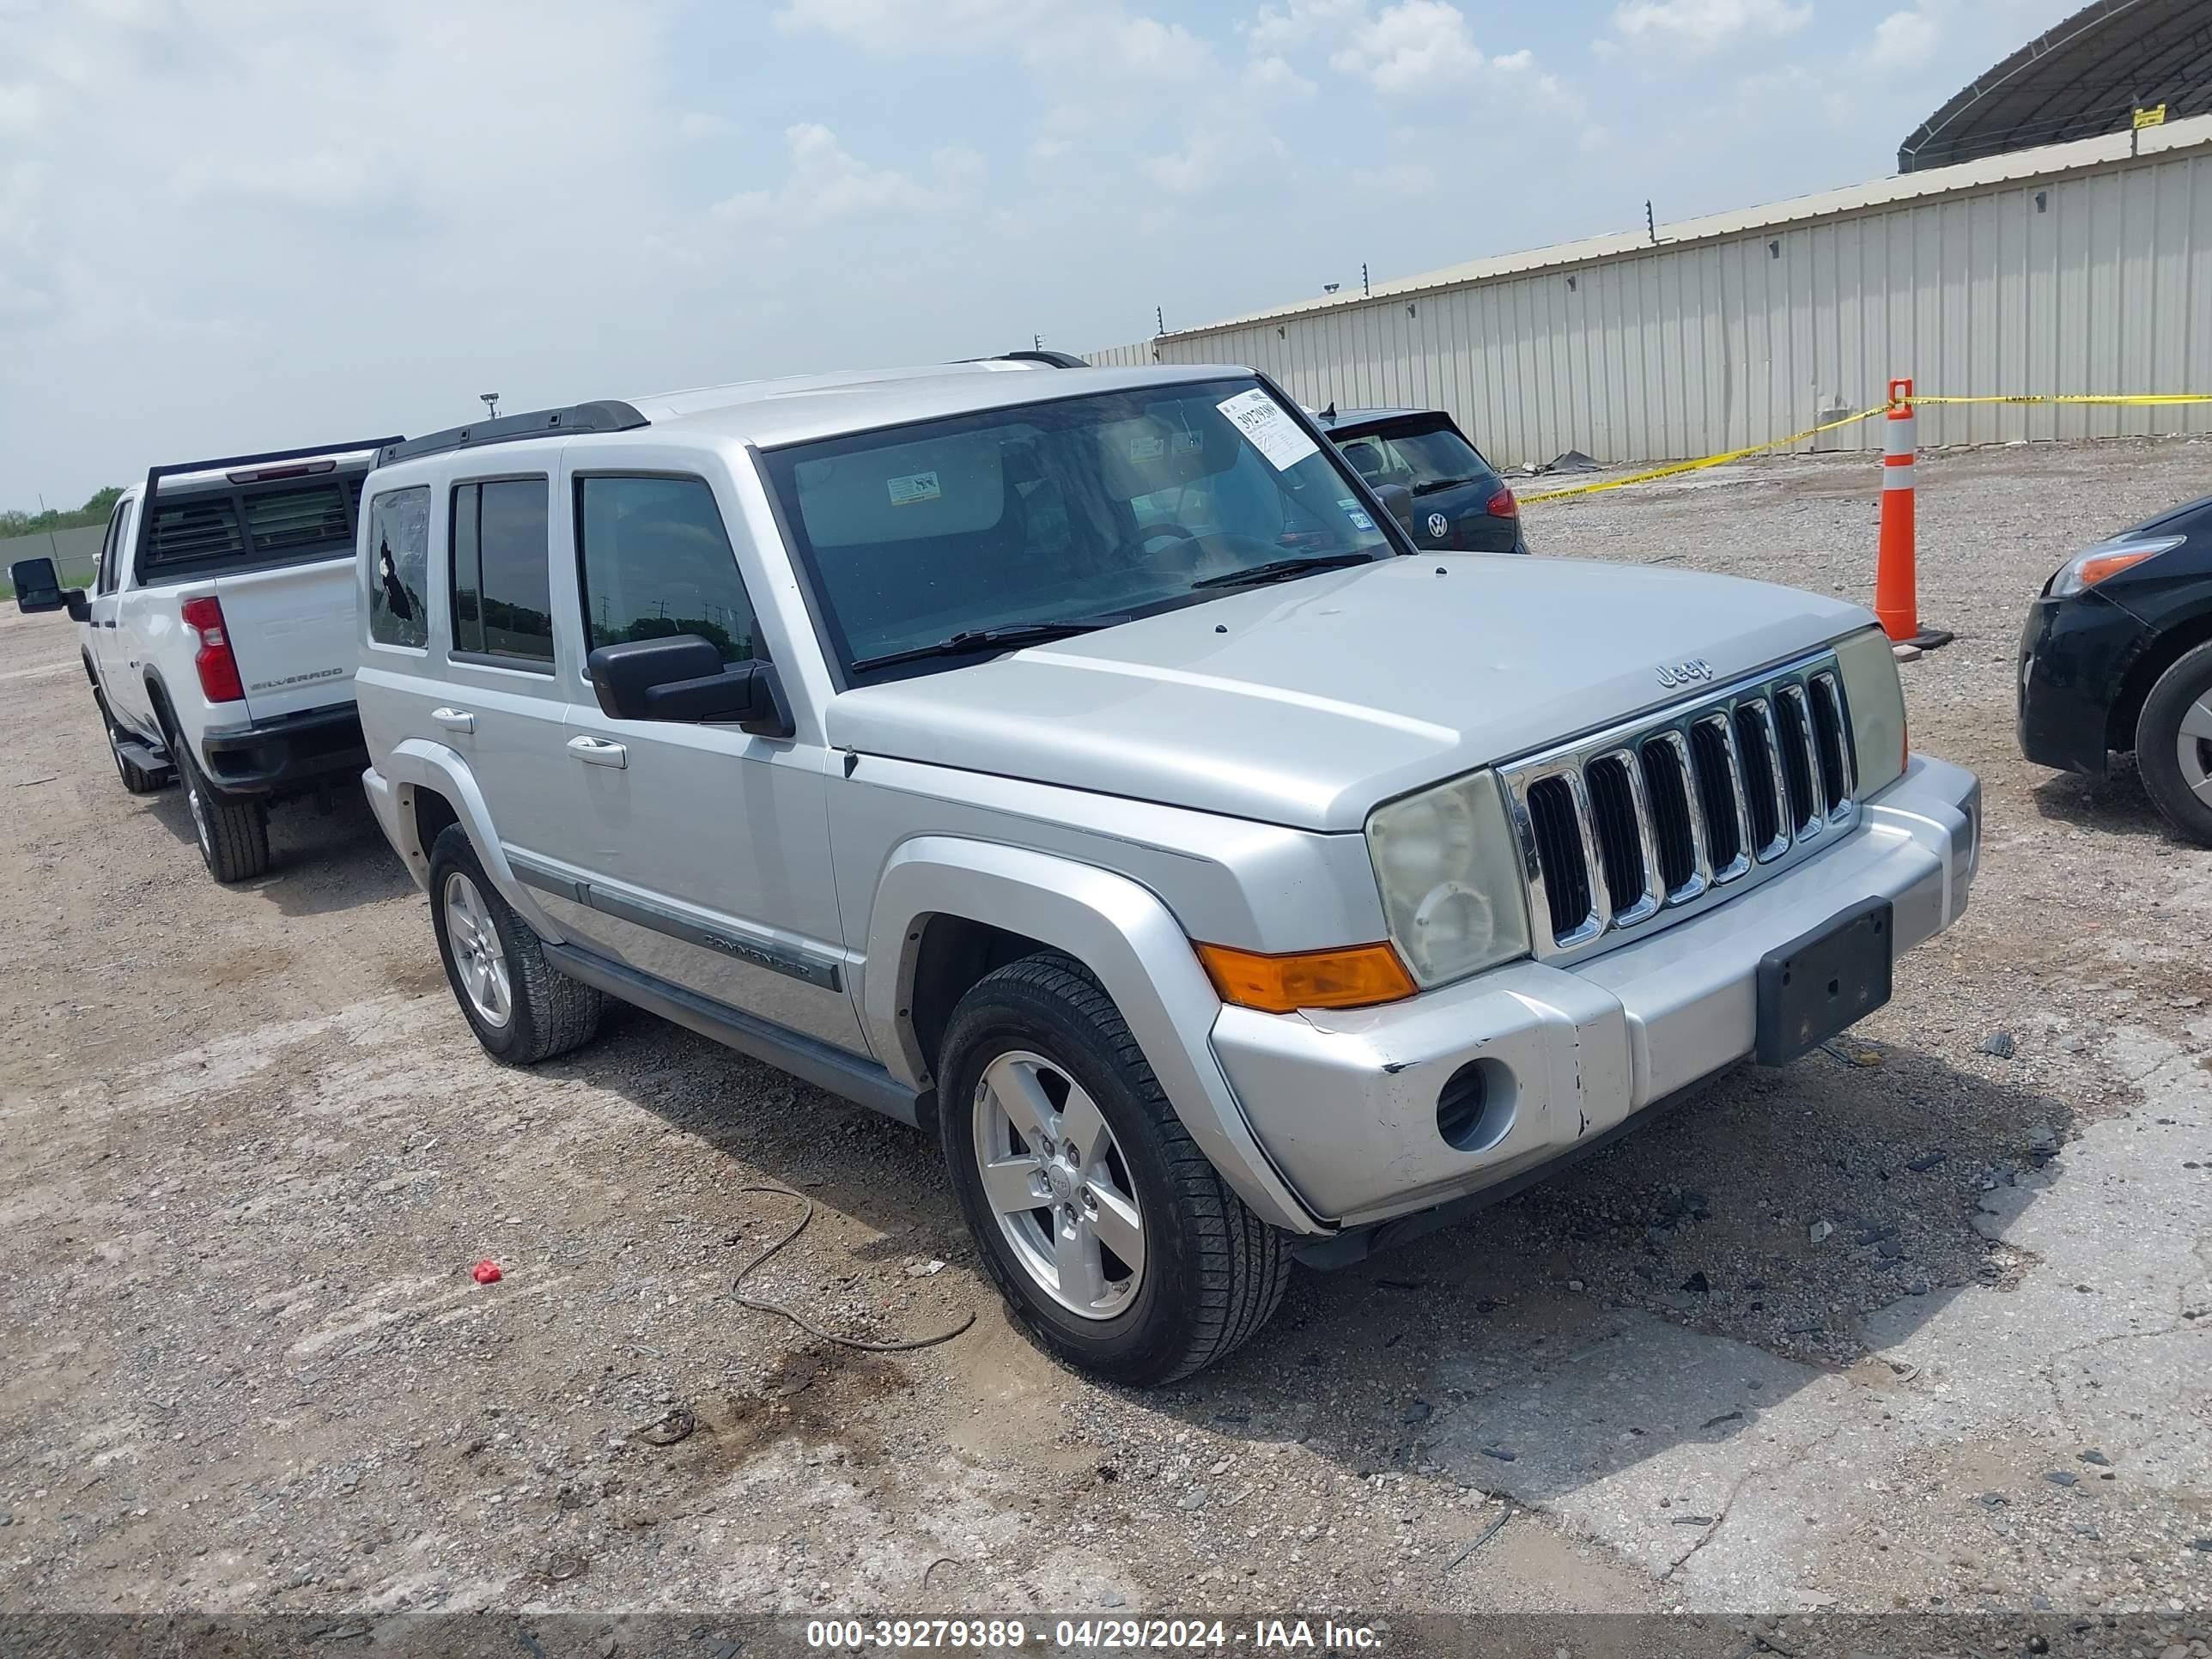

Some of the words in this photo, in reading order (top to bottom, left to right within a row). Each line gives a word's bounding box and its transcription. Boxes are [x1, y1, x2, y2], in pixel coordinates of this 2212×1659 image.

[1237, 403, 1278, 429] 39279389
[250, 667, 343, 691] SILVERADO
[1655, 658, 1713, 689] Jeep
[703, 934, 812, 977] COMMANDER
